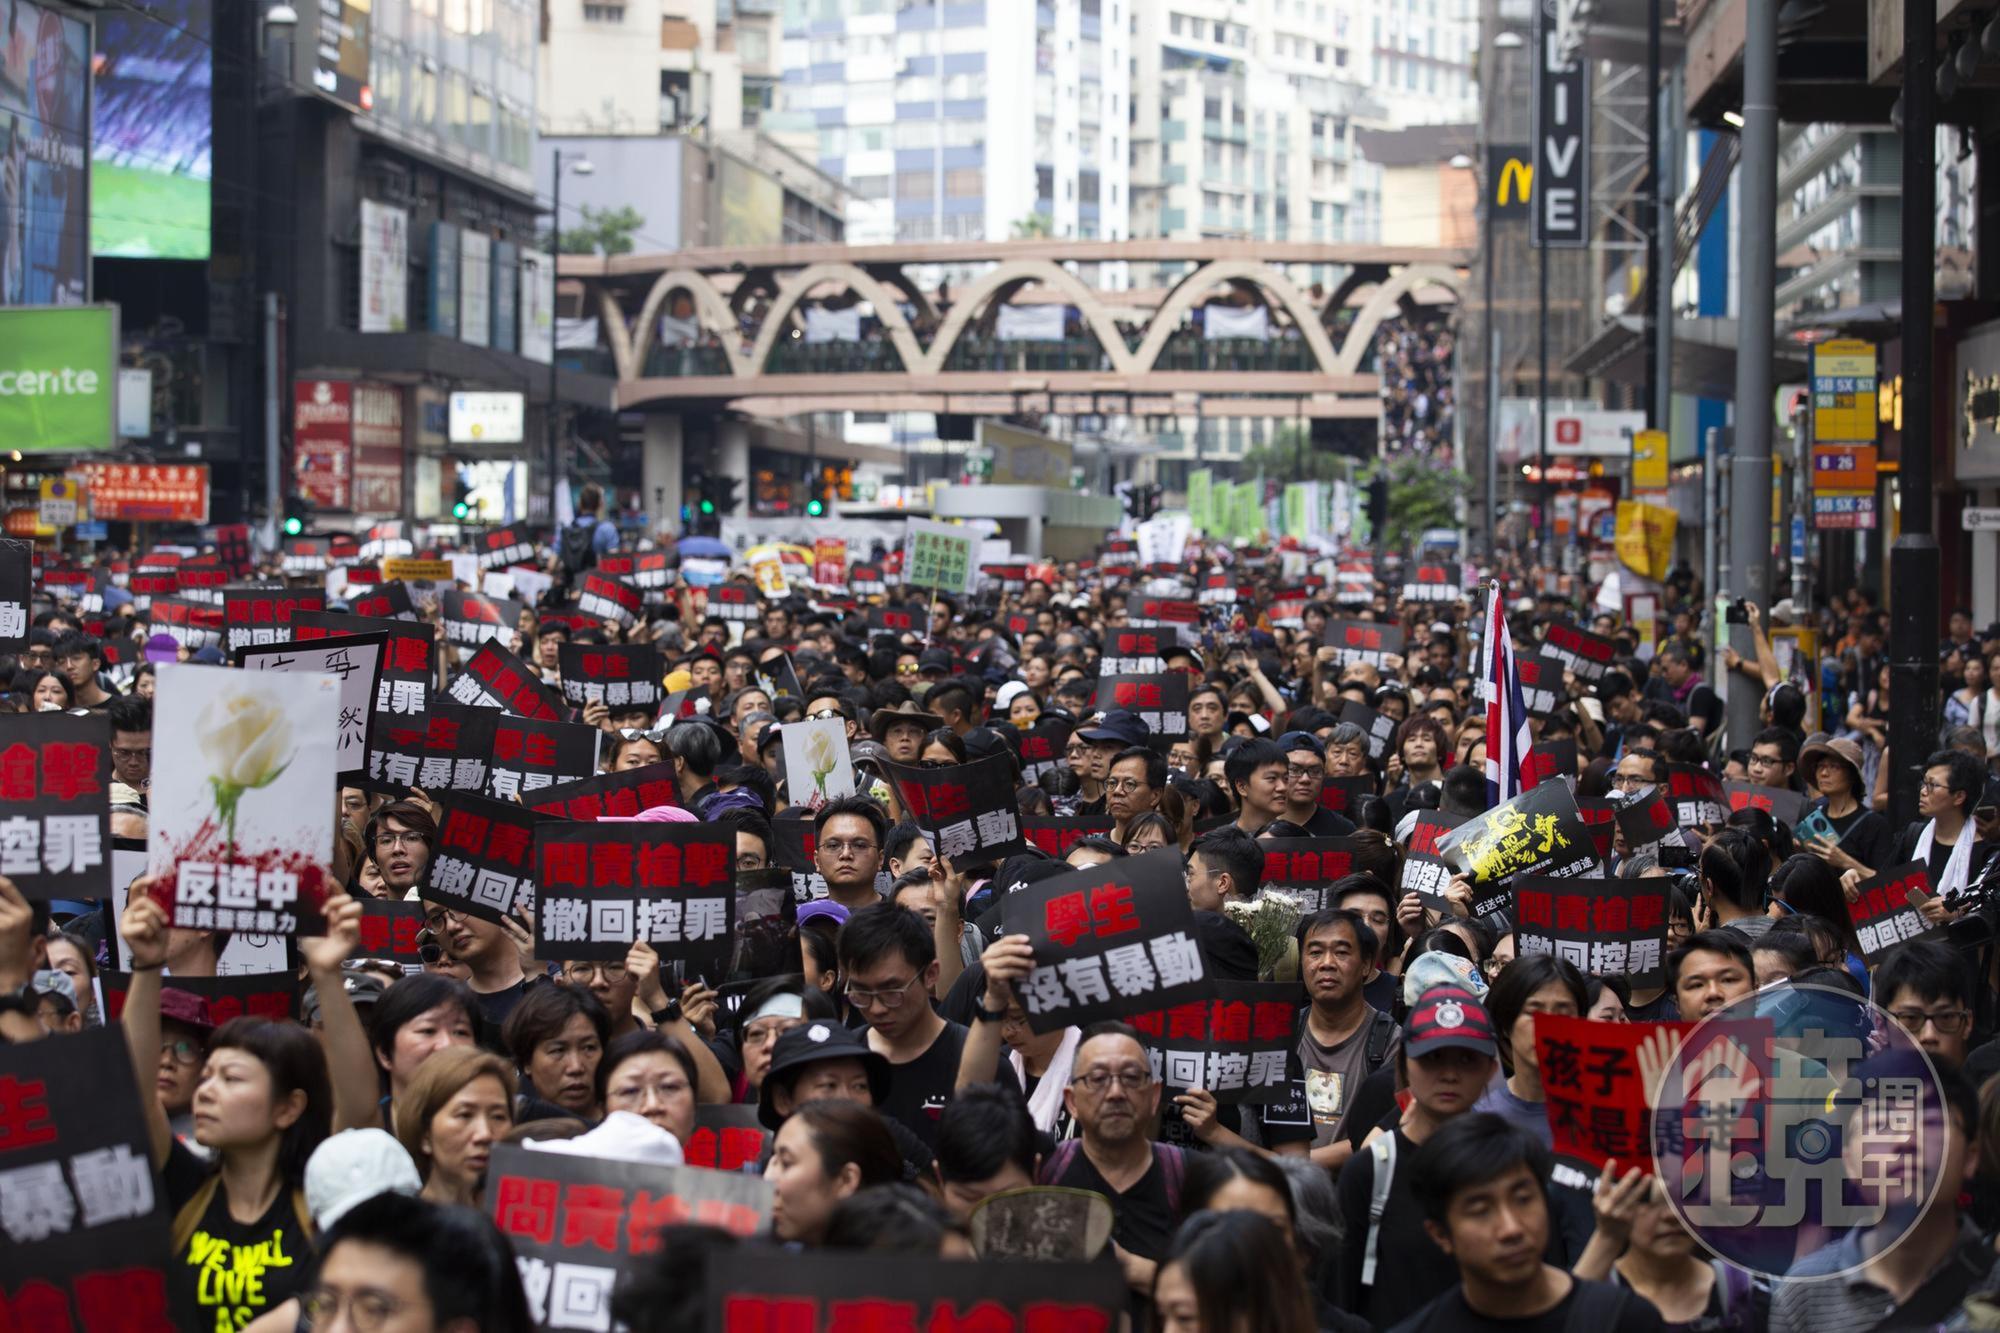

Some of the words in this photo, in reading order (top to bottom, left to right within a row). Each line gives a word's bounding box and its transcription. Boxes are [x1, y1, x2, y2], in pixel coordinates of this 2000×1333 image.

[1545, 29, 1580, 231] LIVE
[1838, 455, 1853, 471] 26
[1857, 496, 1873, 512] 26
[442, 809, 536, 870] 問責
[176, 860, 299, 909] 反送中
[543, 842, 730, 889] 問責槍擊
[542, 897, 728, 944] 撤回控罪
[1045, 882, 1141, 948] 學生
[1019, 930, 1205, 1015] 沒有暴動
[1541, 1036, 1633, 1097] 孩子
[188, 1231, 231, 1272] WE
[231, 1229, 293, 1271] WILL
[198, 1264, 267, 1306] LIVE
